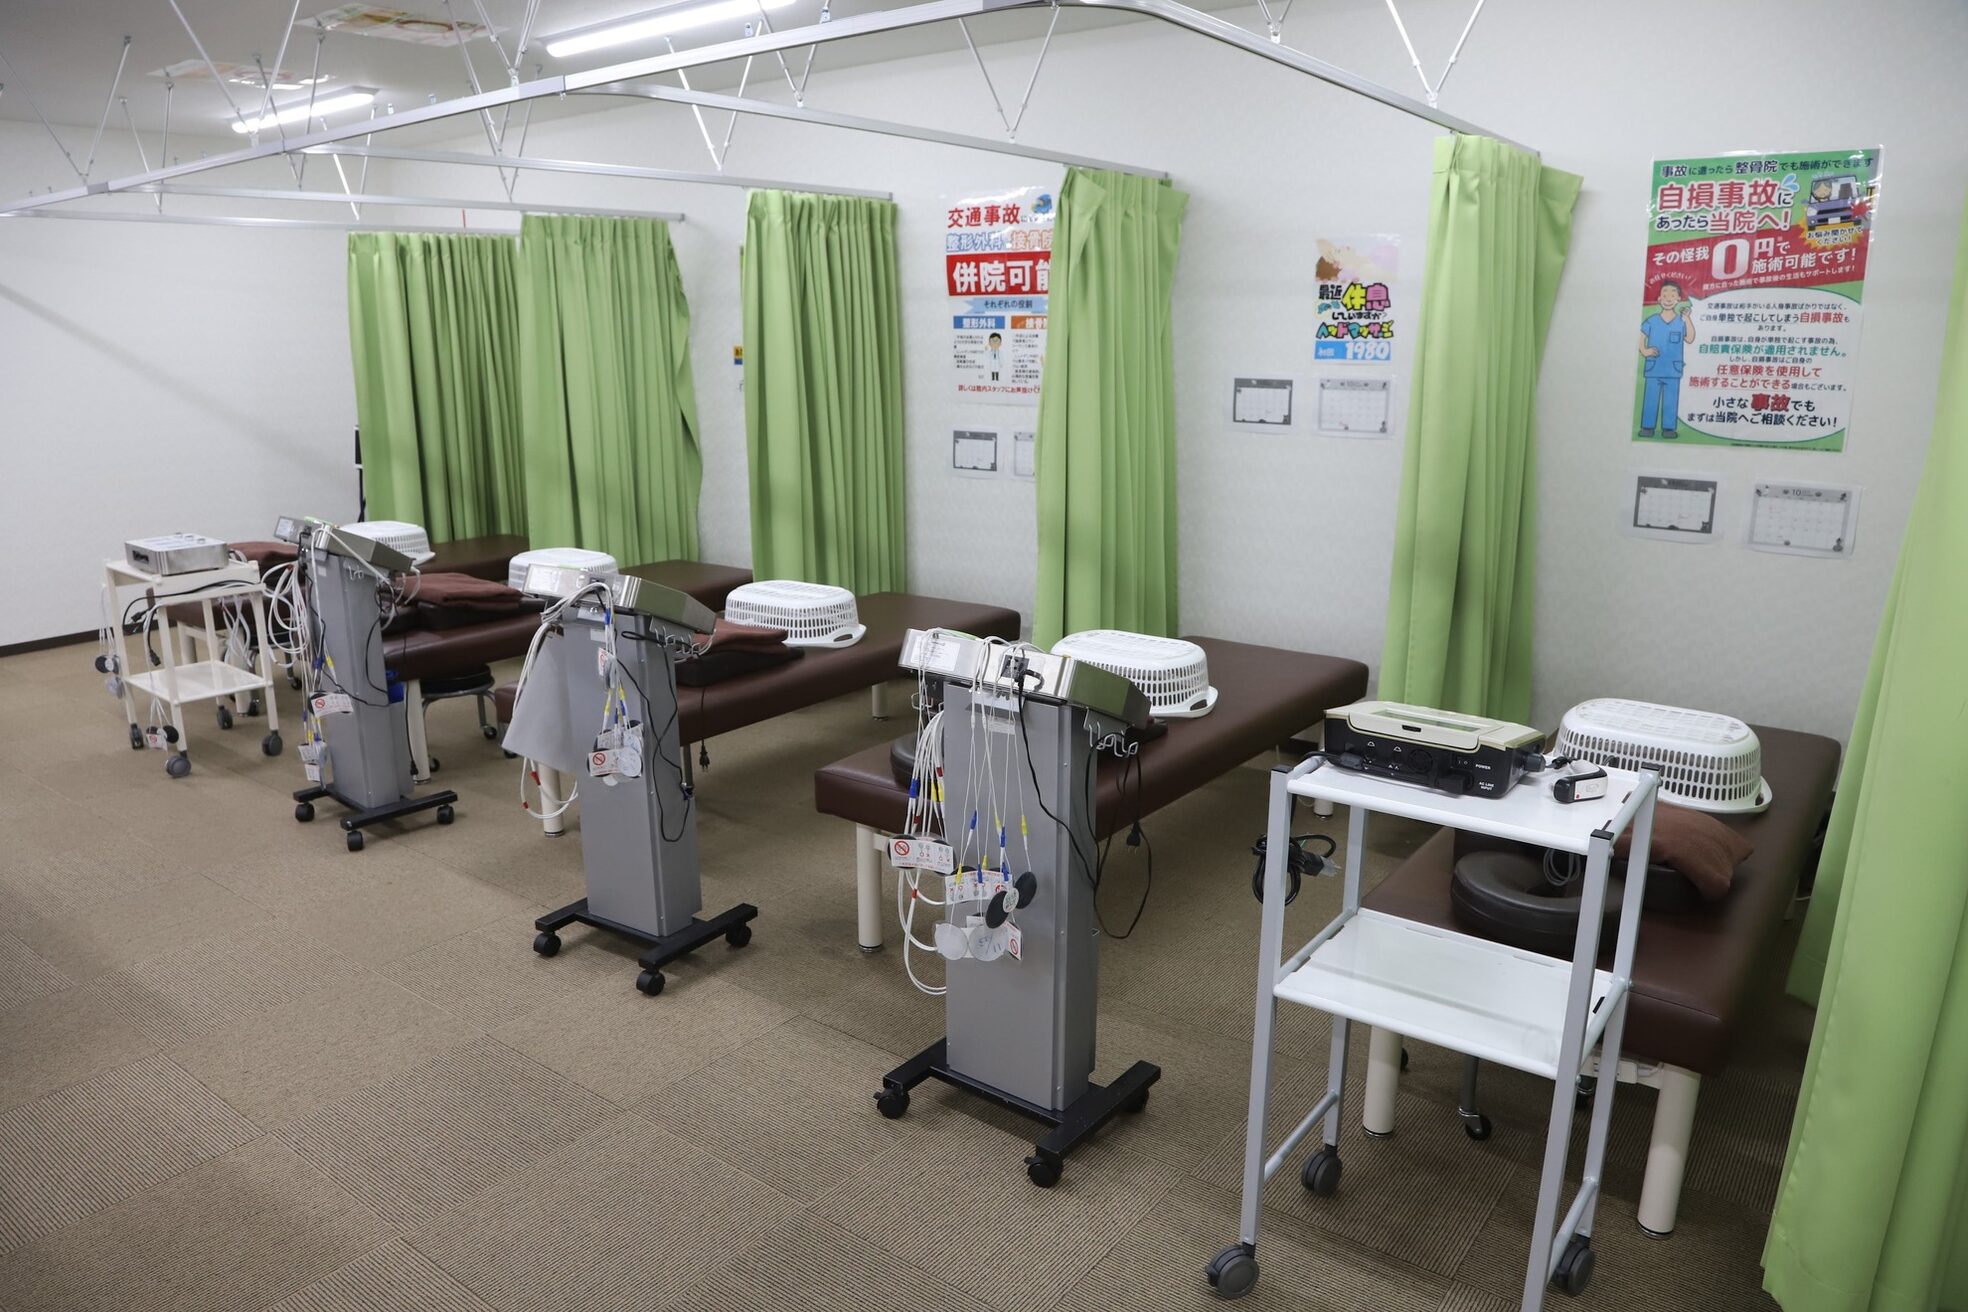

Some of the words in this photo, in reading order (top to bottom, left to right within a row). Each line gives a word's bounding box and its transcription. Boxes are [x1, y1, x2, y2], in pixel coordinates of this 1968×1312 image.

[1658, 178, 1792, 210] 自損事故に
[1751, 247, 1856, 275] 施術可能です!
[983, 299, 1033, 309] それぞれの役割
[1757, 325, 1787, 333] あります。
[1345, 340, 1391, 360] 1980
[1698, 343, 1847, 358] 自賠責保険が適用されません。
[1716, 364, 1822, 378] 任意保険を使用して
[1713, 392, 1816, 413] 小さな事故でも
[1687, 410, 1837, 428] まずは当院へご相談ください!
